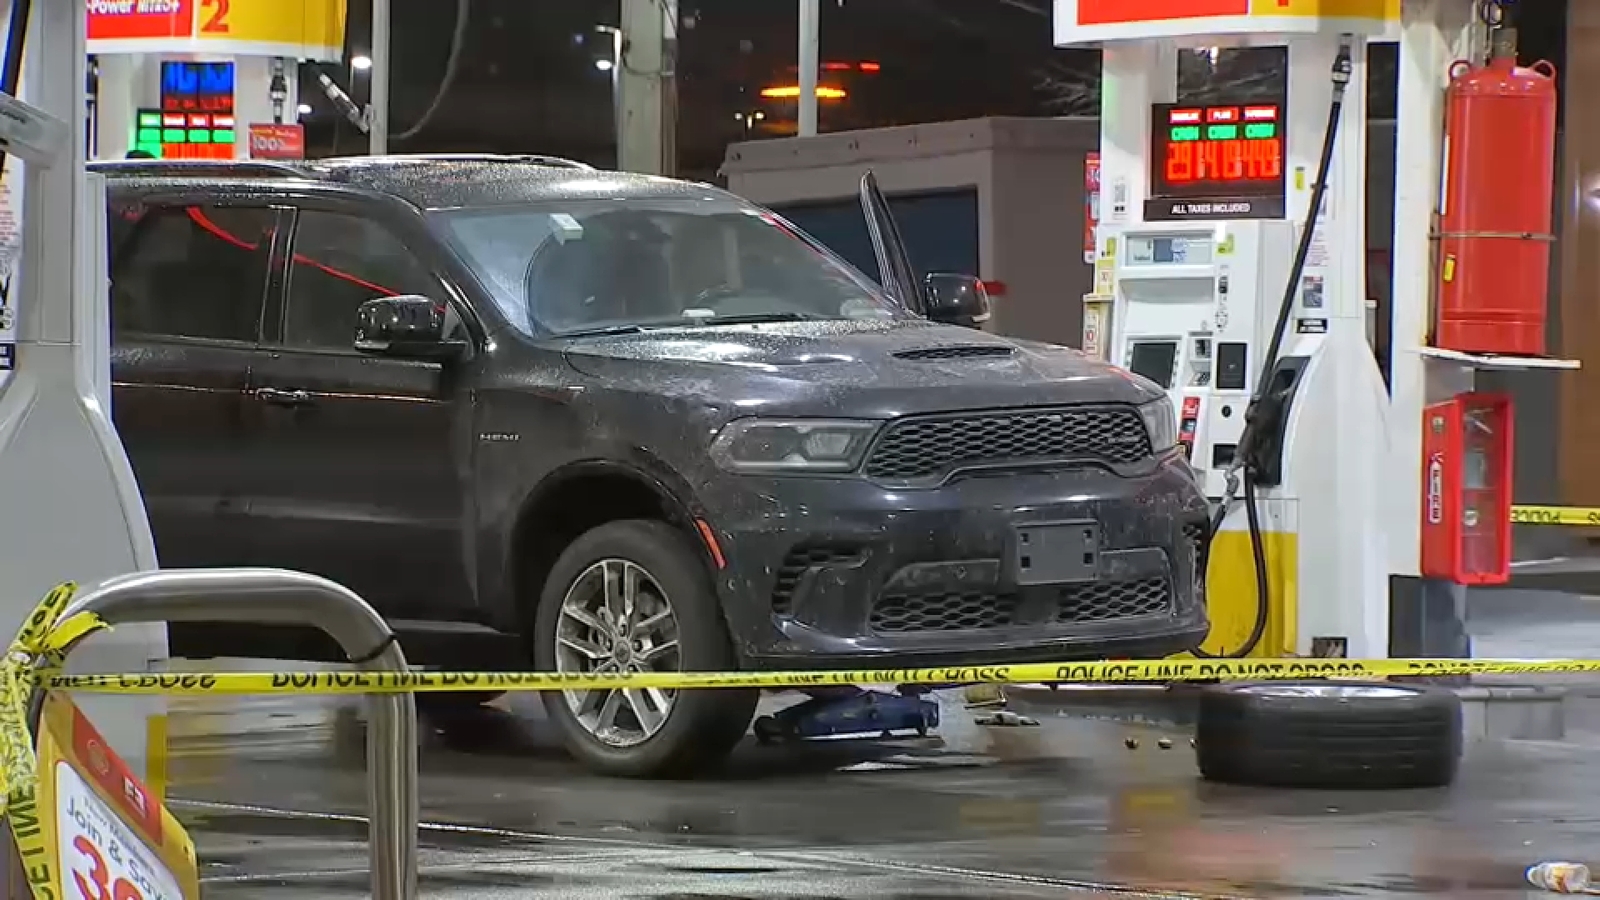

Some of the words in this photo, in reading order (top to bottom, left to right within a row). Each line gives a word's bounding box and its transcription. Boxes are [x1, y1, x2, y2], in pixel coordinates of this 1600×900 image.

[200, 0, 229, 32] 2
[1171, 204, 1187, 214] ALL
[1187, 204, 1211, 213] TAXES
[1213, 203, 1251, 213] INCLUDED
[66, 793, 103, 847] Join
[107, 838, 123, 866] &
